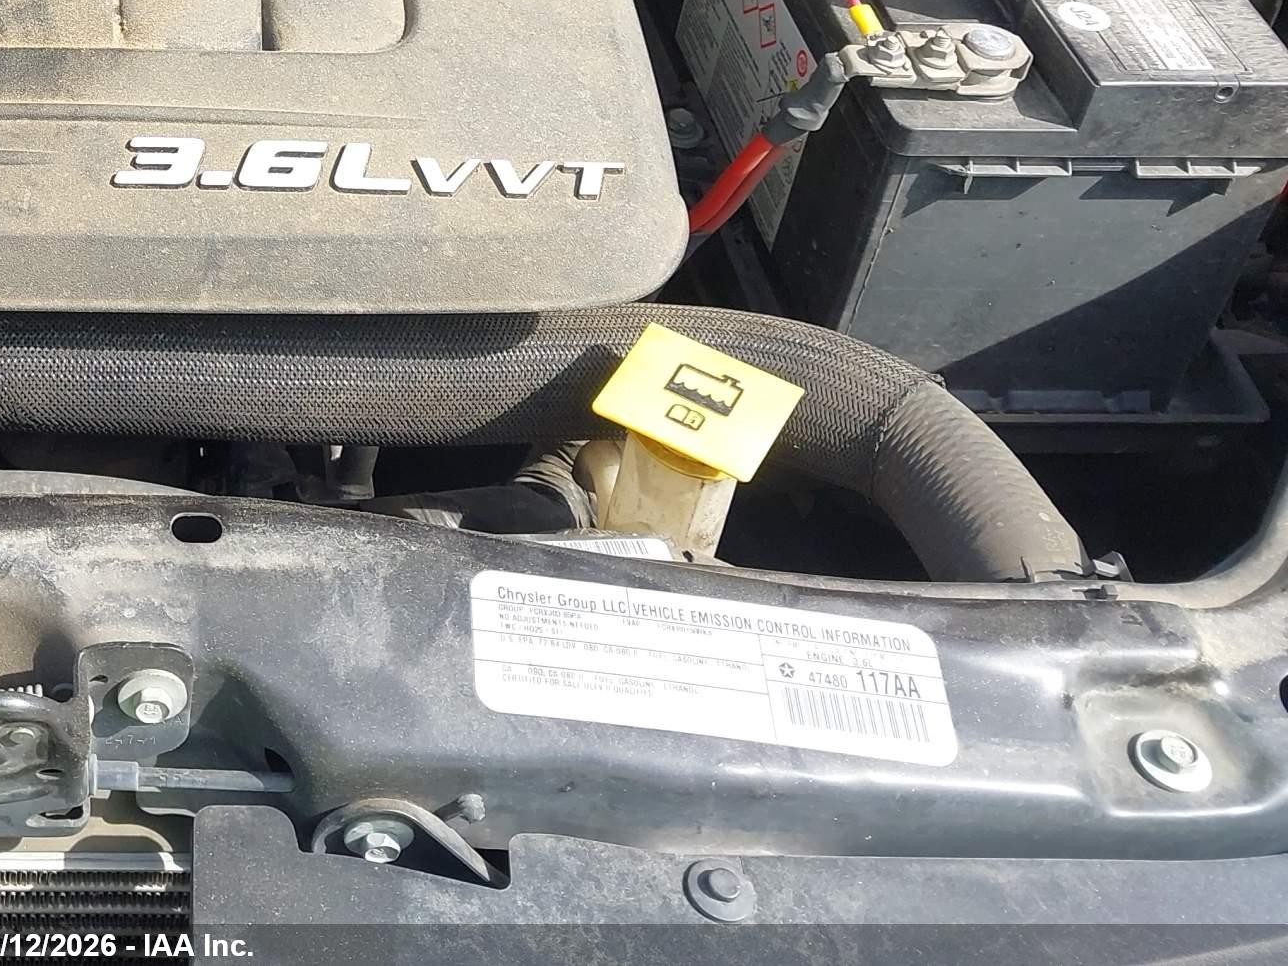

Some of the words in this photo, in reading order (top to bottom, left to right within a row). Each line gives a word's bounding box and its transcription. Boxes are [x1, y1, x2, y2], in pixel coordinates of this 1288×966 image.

[497, 586, 552, 605] Chrysler
[557, 593, 597, 613] Group
[602, 599, 627, 614] LLC
[633, 602, 685, 622] VEHICLE
[691, 610, 752, 631] EMISSION
[757, 618, 817, 639] CONTROL
[822, 628, 911, 652] INFORMATION
[808, 671, 848, 689] 47480
[856, 670, 921, 699] 117AA
